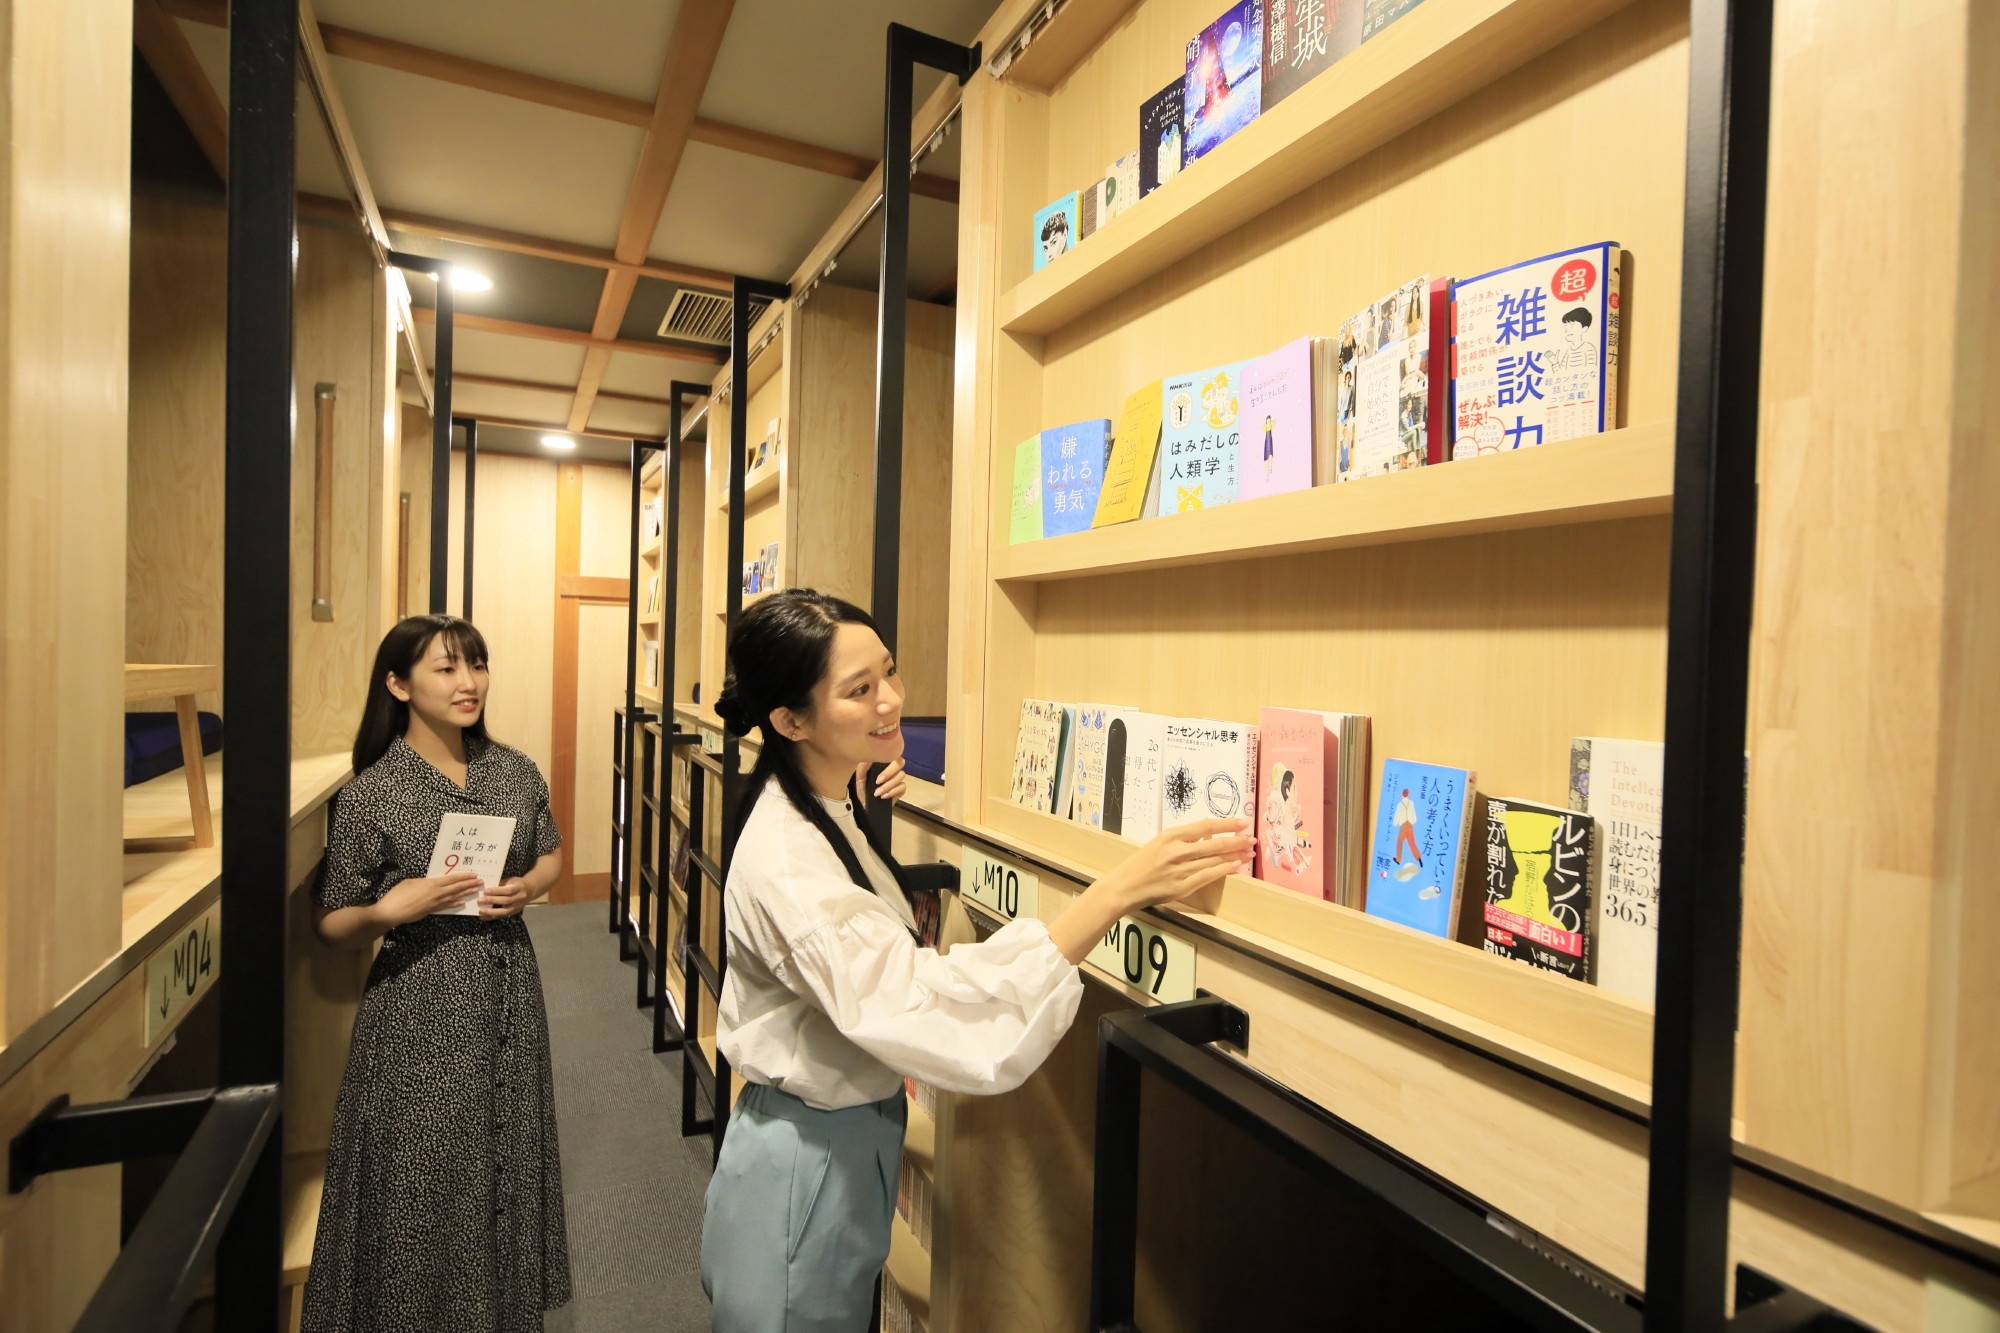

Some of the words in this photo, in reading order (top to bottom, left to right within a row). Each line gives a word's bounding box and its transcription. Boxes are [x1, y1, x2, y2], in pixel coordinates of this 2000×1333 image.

[1559, 268, 1587, 295] 超
[1460, 288, 1504, 308] 人づきあい
[1495, 287, 1547, 450] 雑談力
[1458, 393, 1496, 414] ぜんぶ
[1060, 435, 1077, 460] 嫌
[1171, 432, 1239, 456] はみだしの
[1047, 459, 1092, 485] われる
[1169, 457, 1220, 480] 人類学
[1053, 489, 1084, 515] 勇気
[1167, 724, 1239, 744] エッセンシャル思考
[1612, 761, 1638, 776] The
[1421, 777, 1441, 857] 人の考え方
[456, 826, 478, 836] 人は
[1433, 779, 1454, 894] うまくいっている
[451, 840, 498, 852] 話し方が
[444, 853, 474, 875] 9割
[1550, 814, 1586, 933] ルビンの
[984, 860, 1019, 919] M10
[1605, 894, 1647, 928] 365
[173, 915, 211, 997] M04
[1104, 919, 1168, 996] M09
